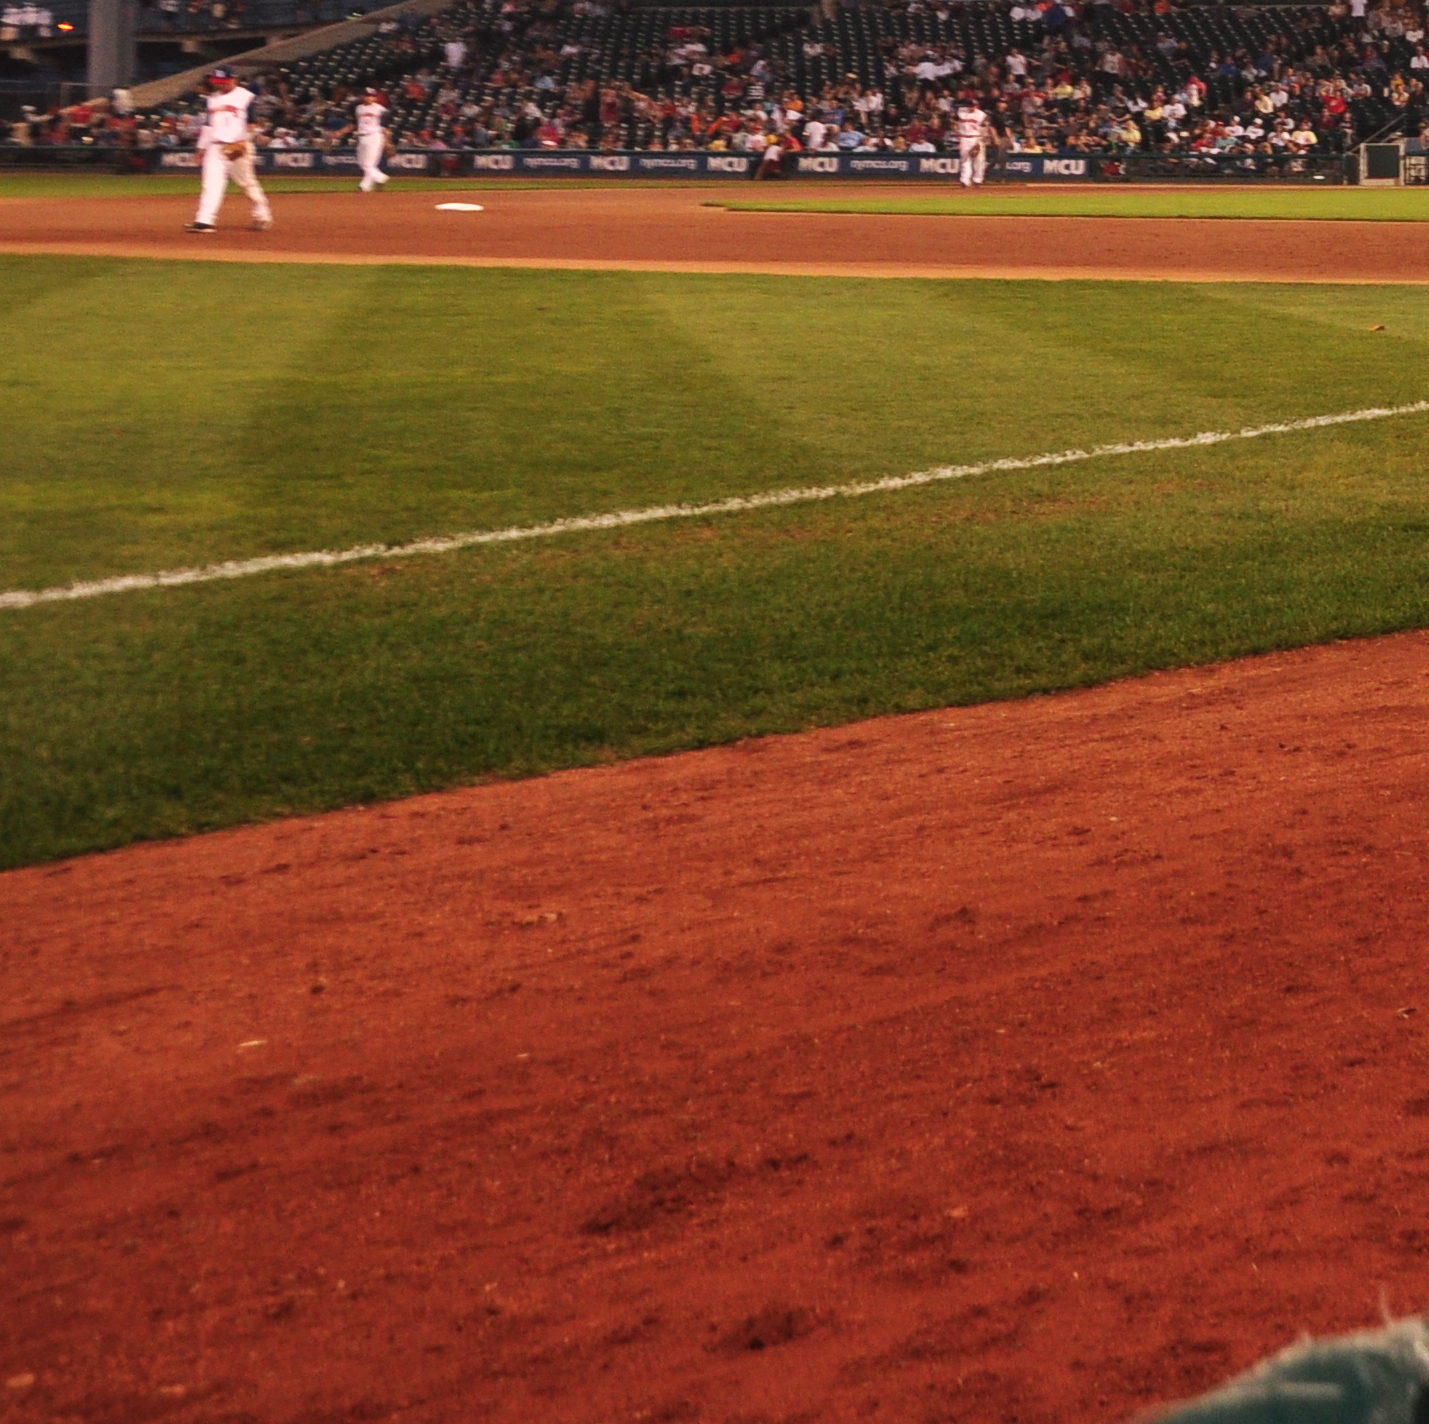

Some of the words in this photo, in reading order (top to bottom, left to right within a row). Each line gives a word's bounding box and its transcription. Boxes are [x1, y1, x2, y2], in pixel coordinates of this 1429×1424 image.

[273, 153, 314, 168] MCU
[474, 154, 514, 170] MCU
[589, 155, 630, 171] MCU
[707, 156, 749, 172] MCU
[797, 157, 839, 173] MCU
[919, 158, 960, 174] MCU
[1043, 159, 1086, 175] MCU
